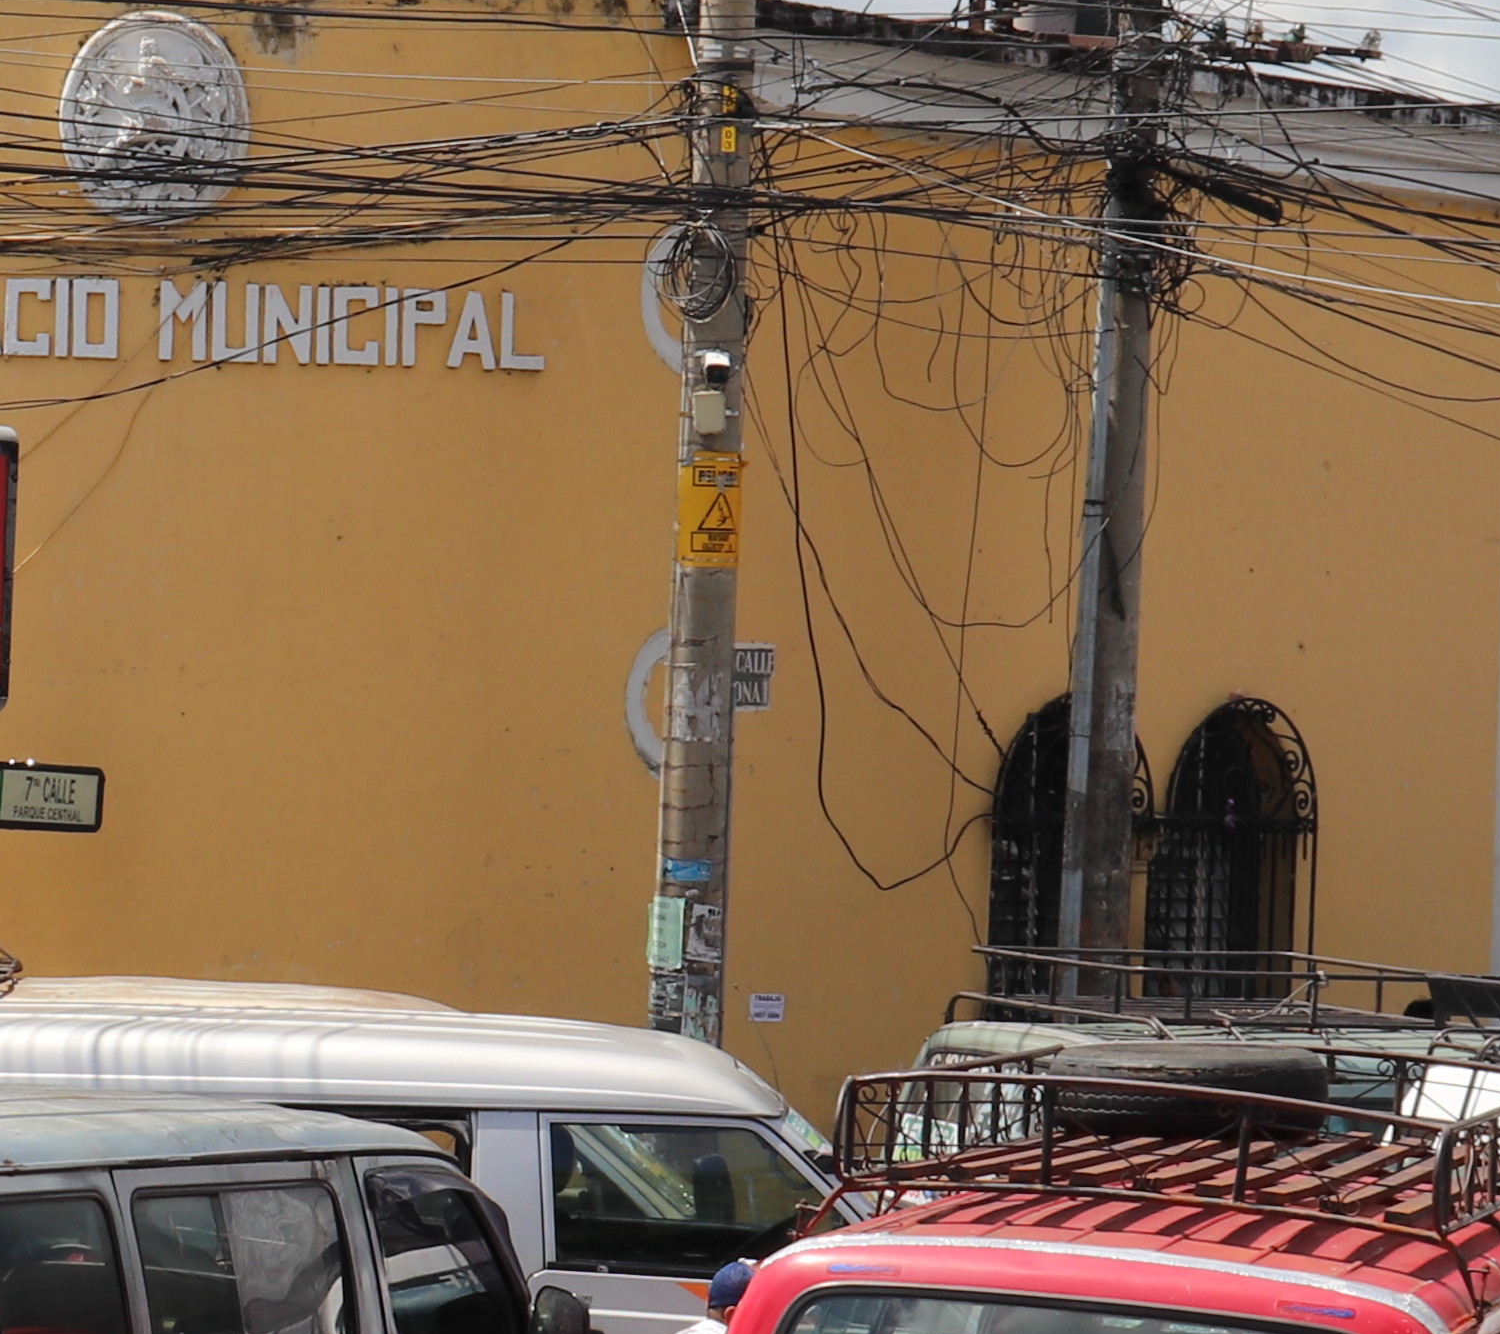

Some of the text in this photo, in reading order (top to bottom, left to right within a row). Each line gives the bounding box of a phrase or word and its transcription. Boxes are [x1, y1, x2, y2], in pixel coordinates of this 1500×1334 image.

[158, 279, 546, 372] MUNICIPAL
[736, 651, 775, 674] CALLE
[733, 680, 760, 703] ONA
[43, 777, 76, 805] CALLE
[13, 805, 82, 822] PARQUE CENTRAL
